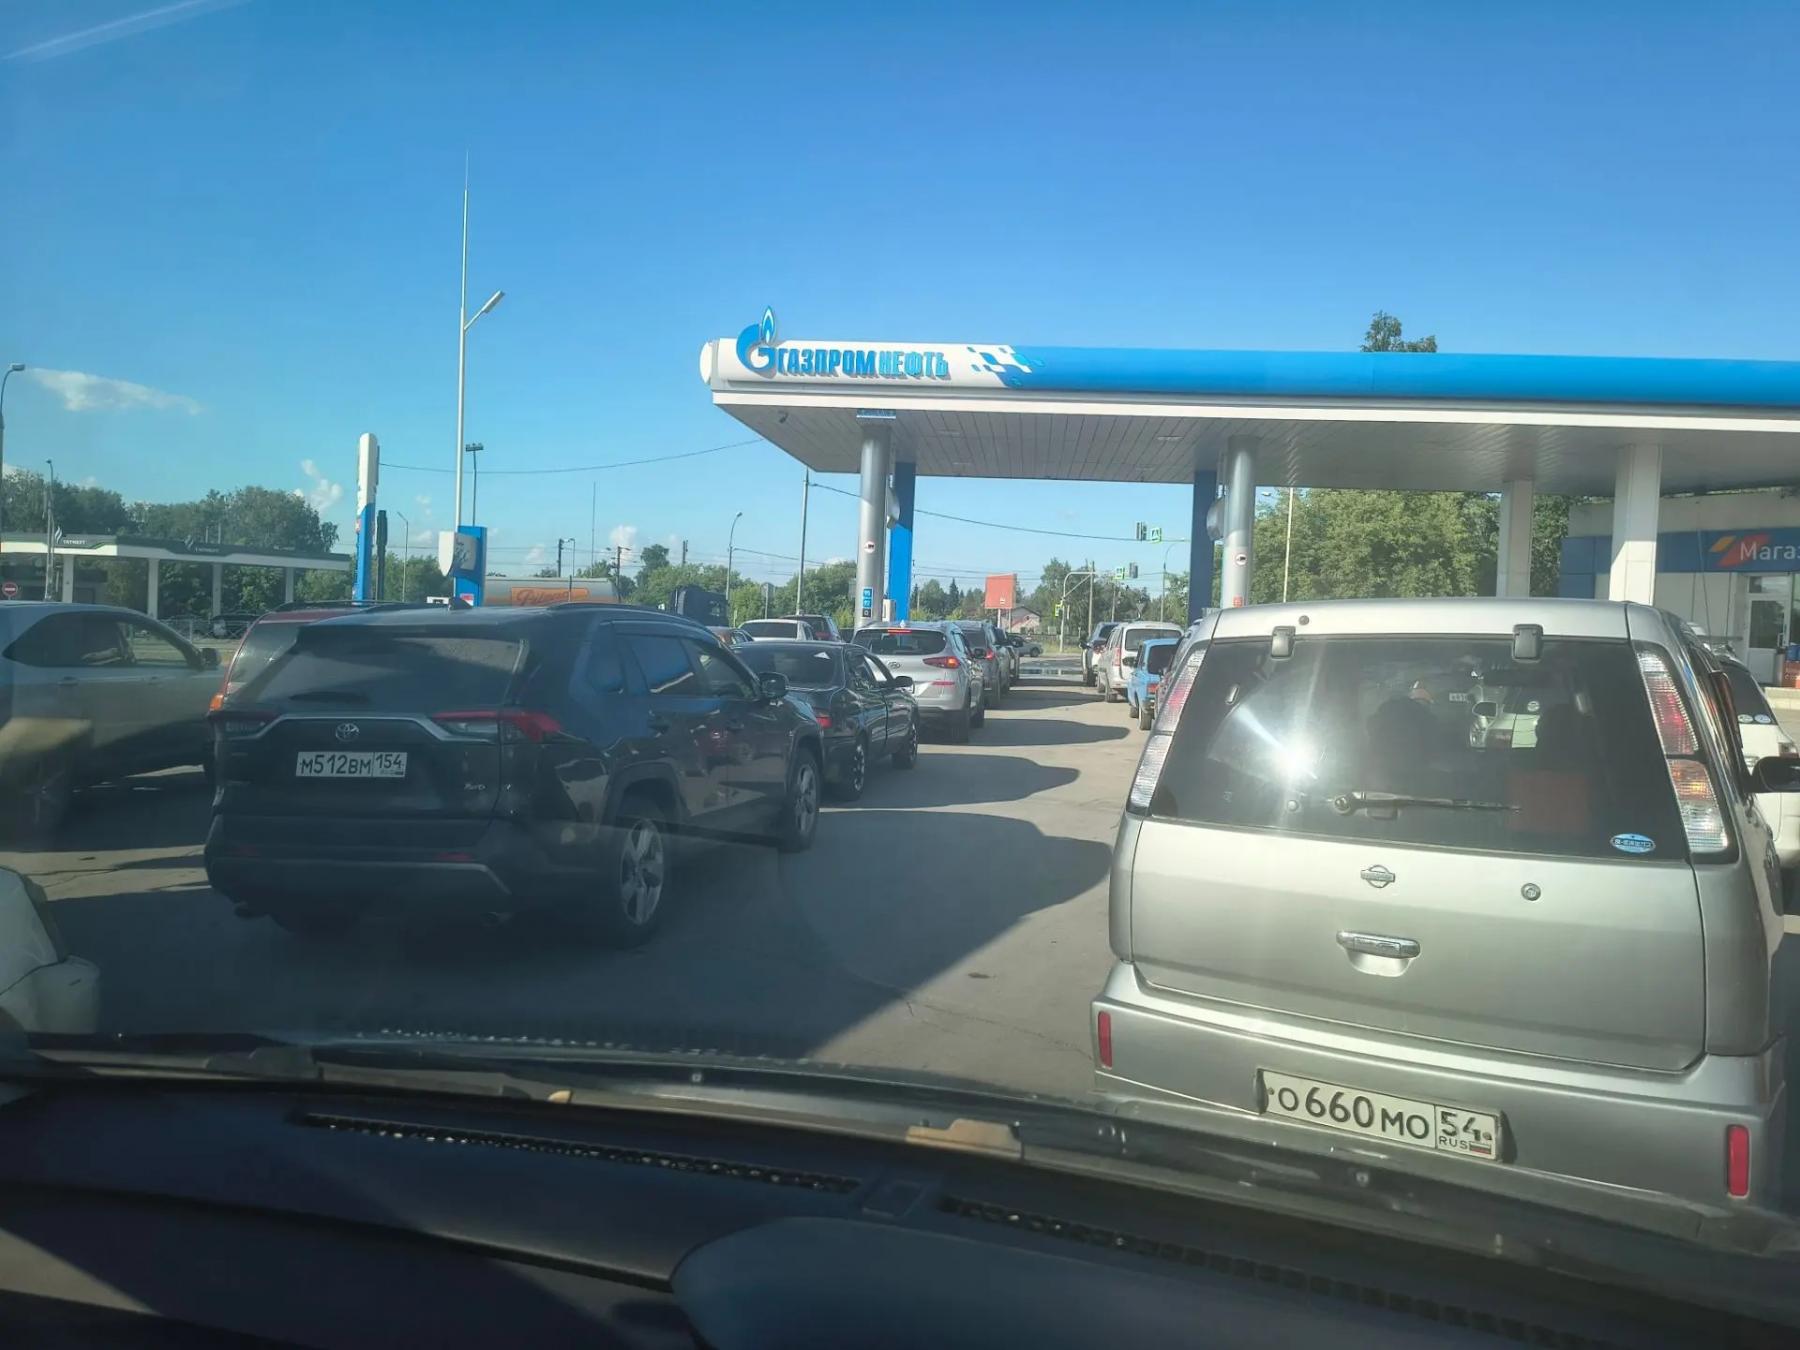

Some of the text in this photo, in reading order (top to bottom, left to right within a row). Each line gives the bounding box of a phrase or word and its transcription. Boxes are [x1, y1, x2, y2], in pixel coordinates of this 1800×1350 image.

[777, 347, 950, 379] ГАЗПРОМНЕФТЬ
[300, 754, 402, 774] М512ВМ 154
[1441, 1110, 1482, 1142] 54
[1438, 1135, 1468, 1150] RUS
